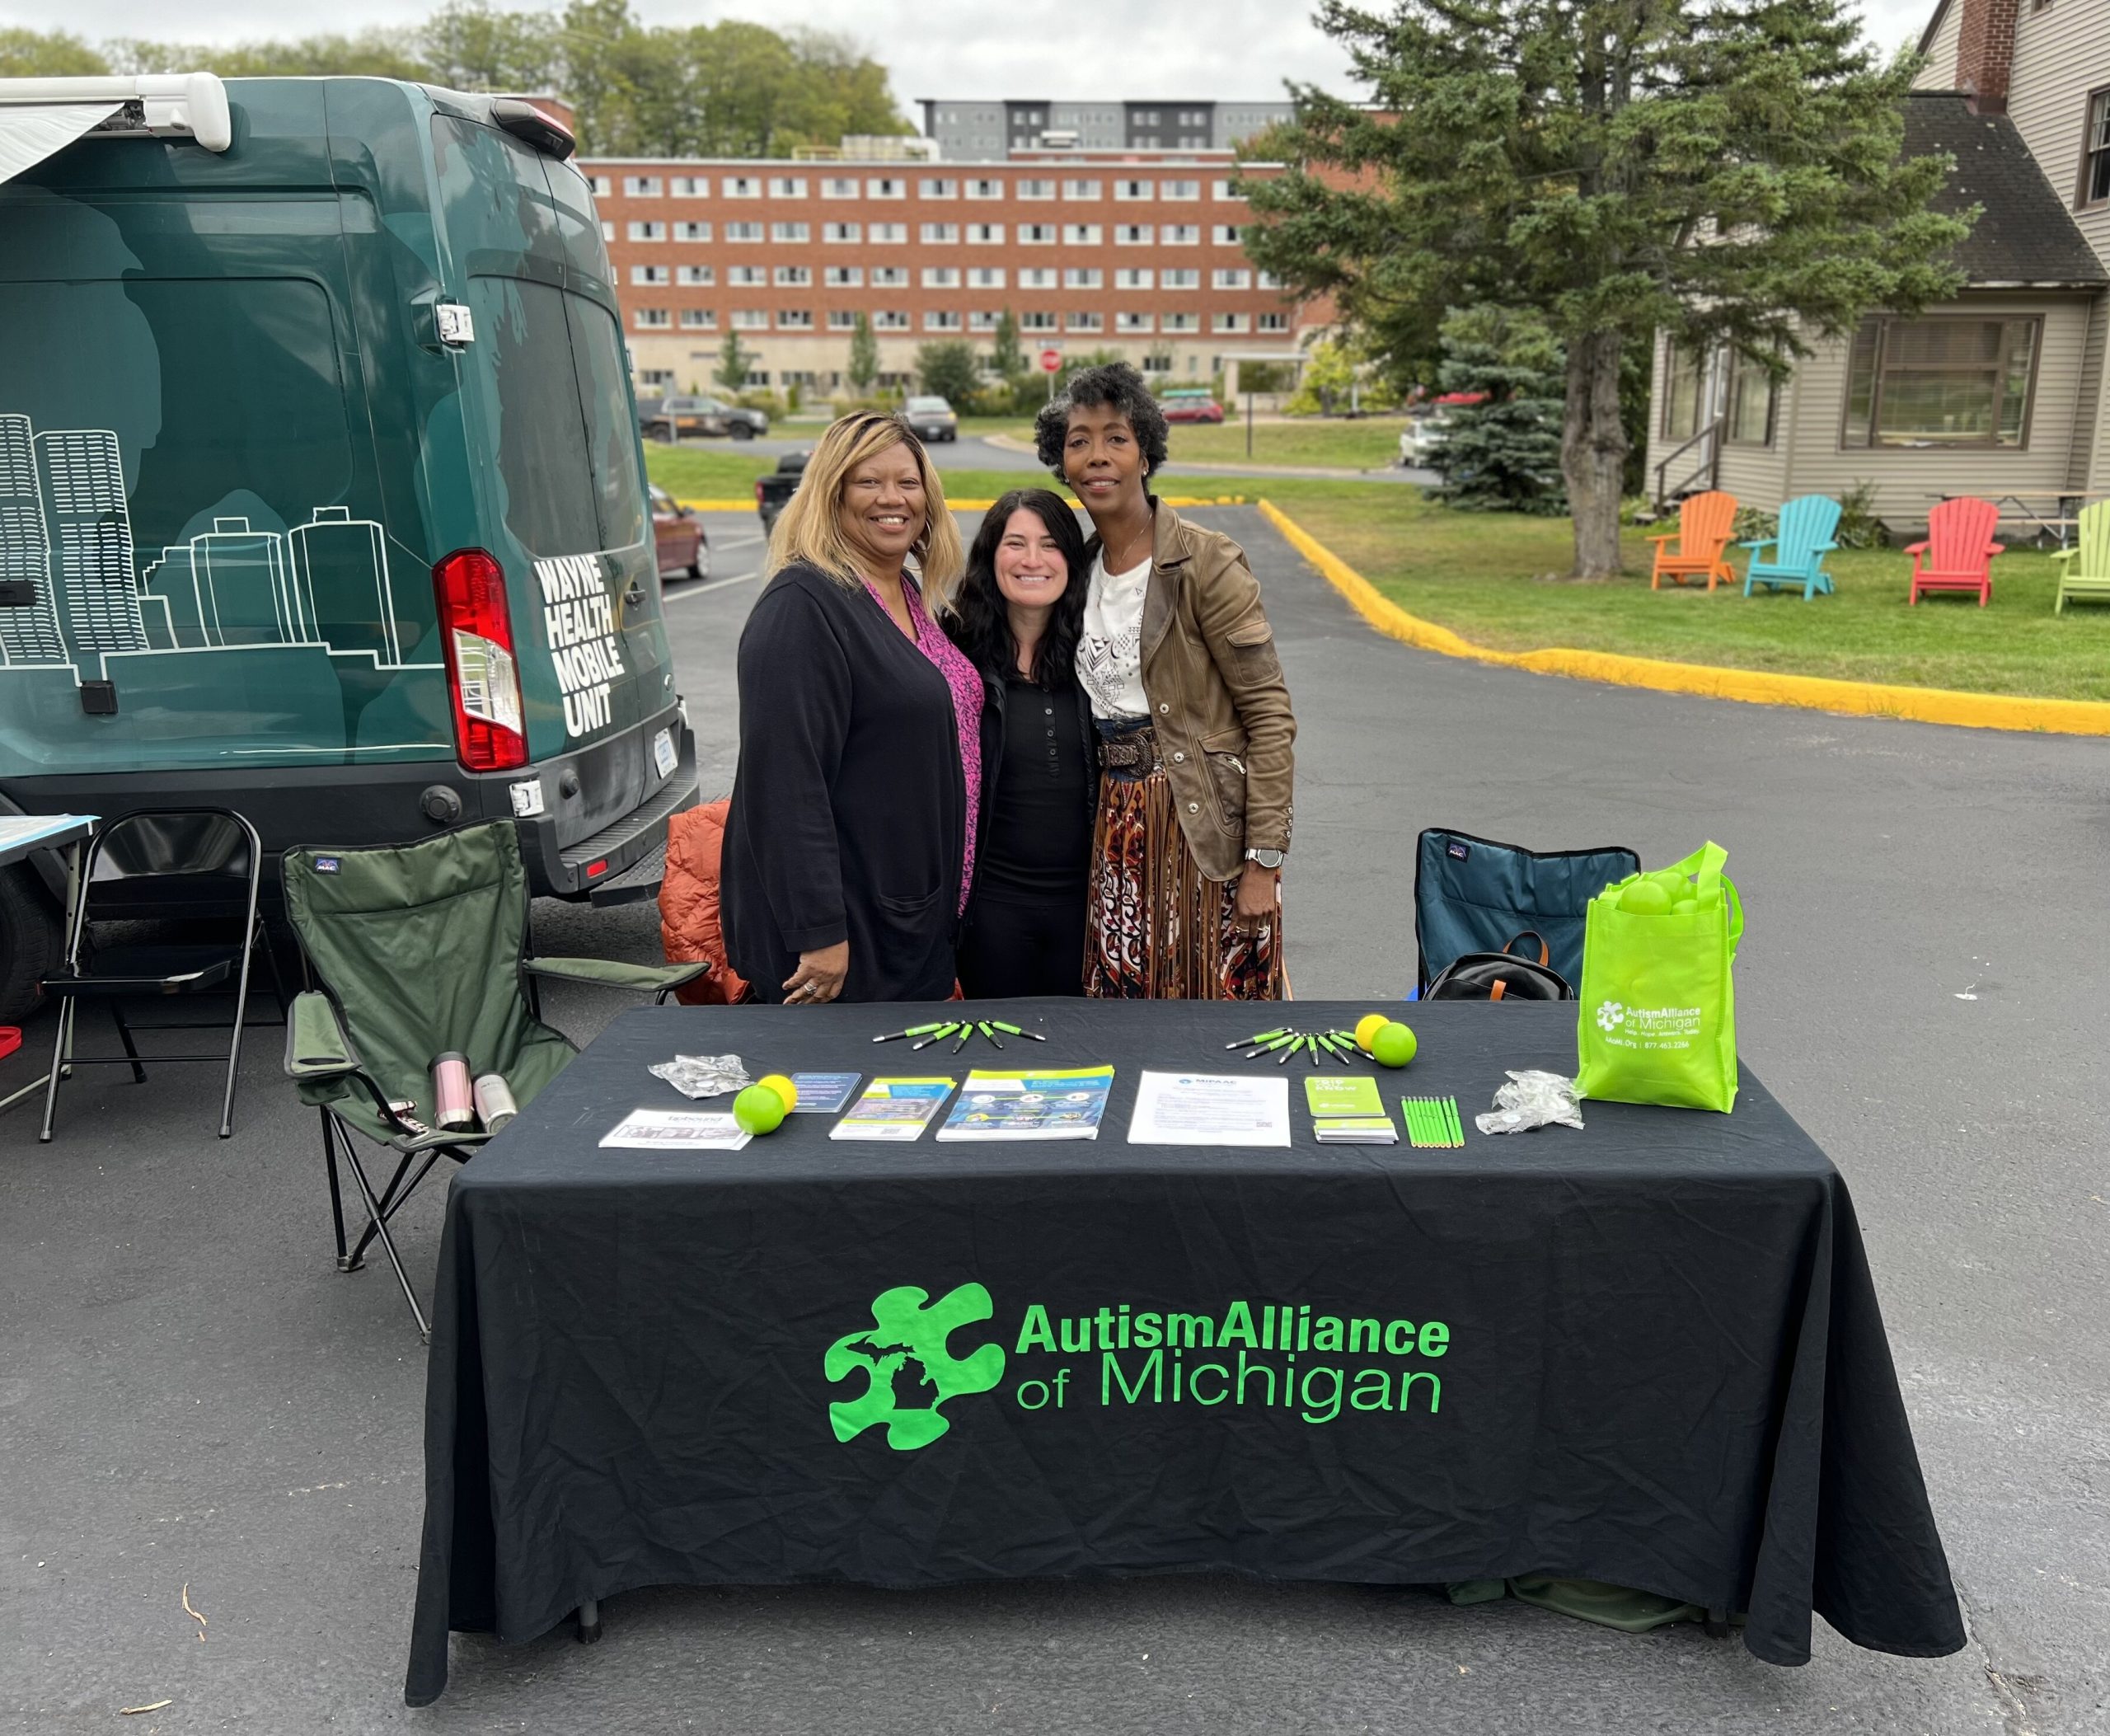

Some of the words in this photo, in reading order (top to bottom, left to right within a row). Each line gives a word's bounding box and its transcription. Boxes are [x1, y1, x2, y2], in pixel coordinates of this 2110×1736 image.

[533, 554, 605, 604] WAYNE
[544, 594, 614, 650] HEALTH
[551, 636, 625, 694] MOBILE
[562, 683, 612, 738] UNIT
[1625, 1019, 1636, 1028] of
[1639, 1016, 1700, 1030] Michigan
[1626, 1006, 1701, 1018] AutismAlliance
[1015, 1302, 1450, 1358] AutismAlliance
[1017, 1369, 1070, 1410] of
[1102, 1349, 1441, 1424] Michigan
